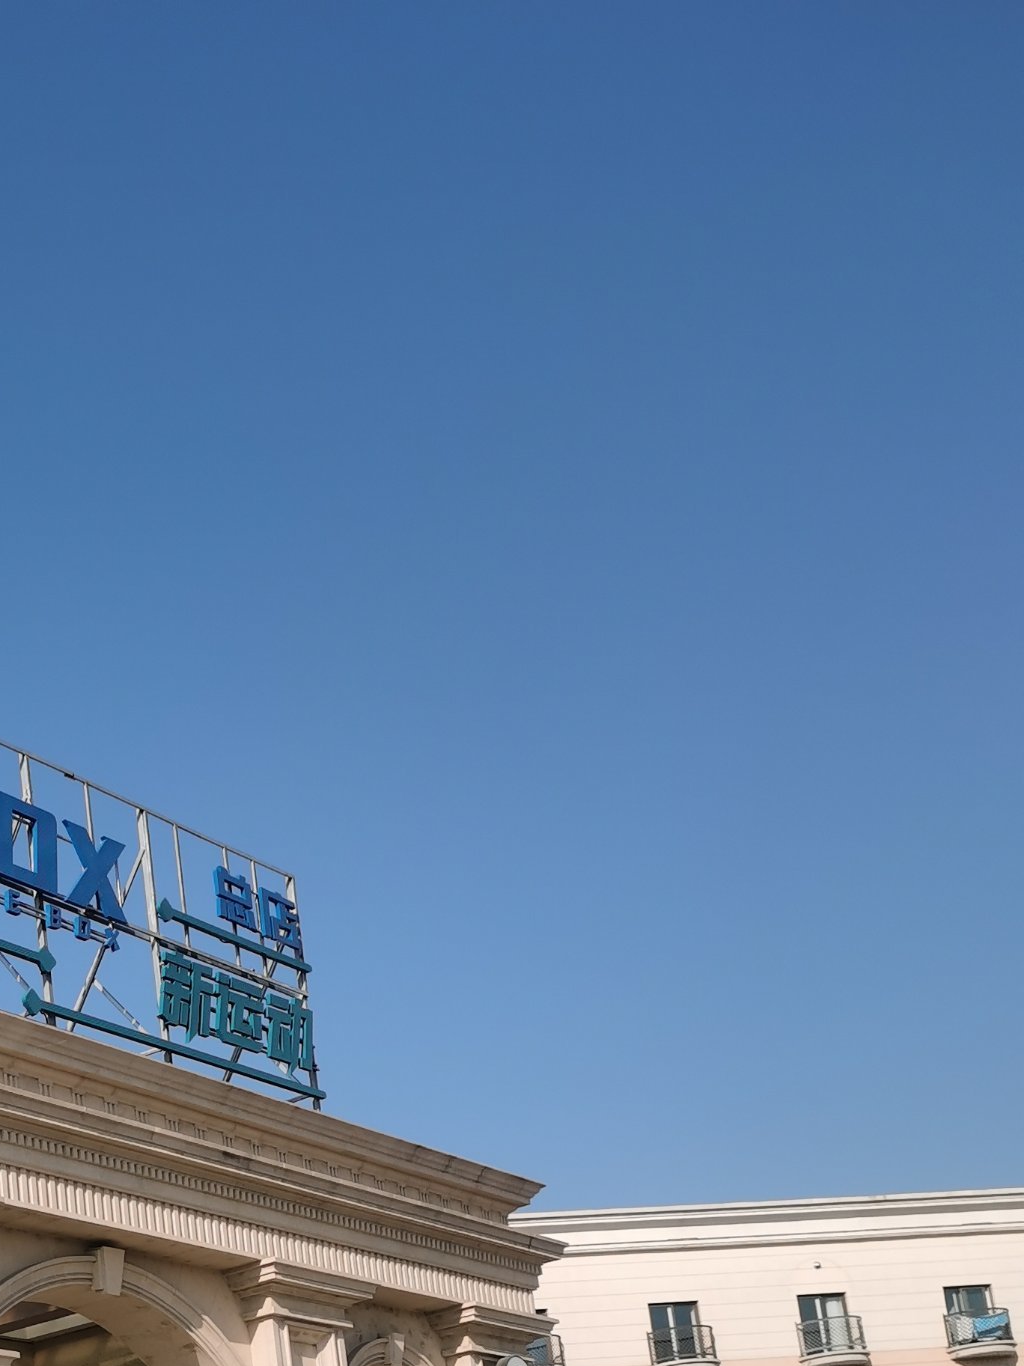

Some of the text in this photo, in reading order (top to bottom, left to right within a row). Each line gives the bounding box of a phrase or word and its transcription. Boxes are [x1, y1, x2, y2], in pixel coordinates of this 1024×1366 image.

[45, 904, 120, 952] BOX
[213, 866, 303, 950] 总店
[157, 950, 314, 1077] 新运动
